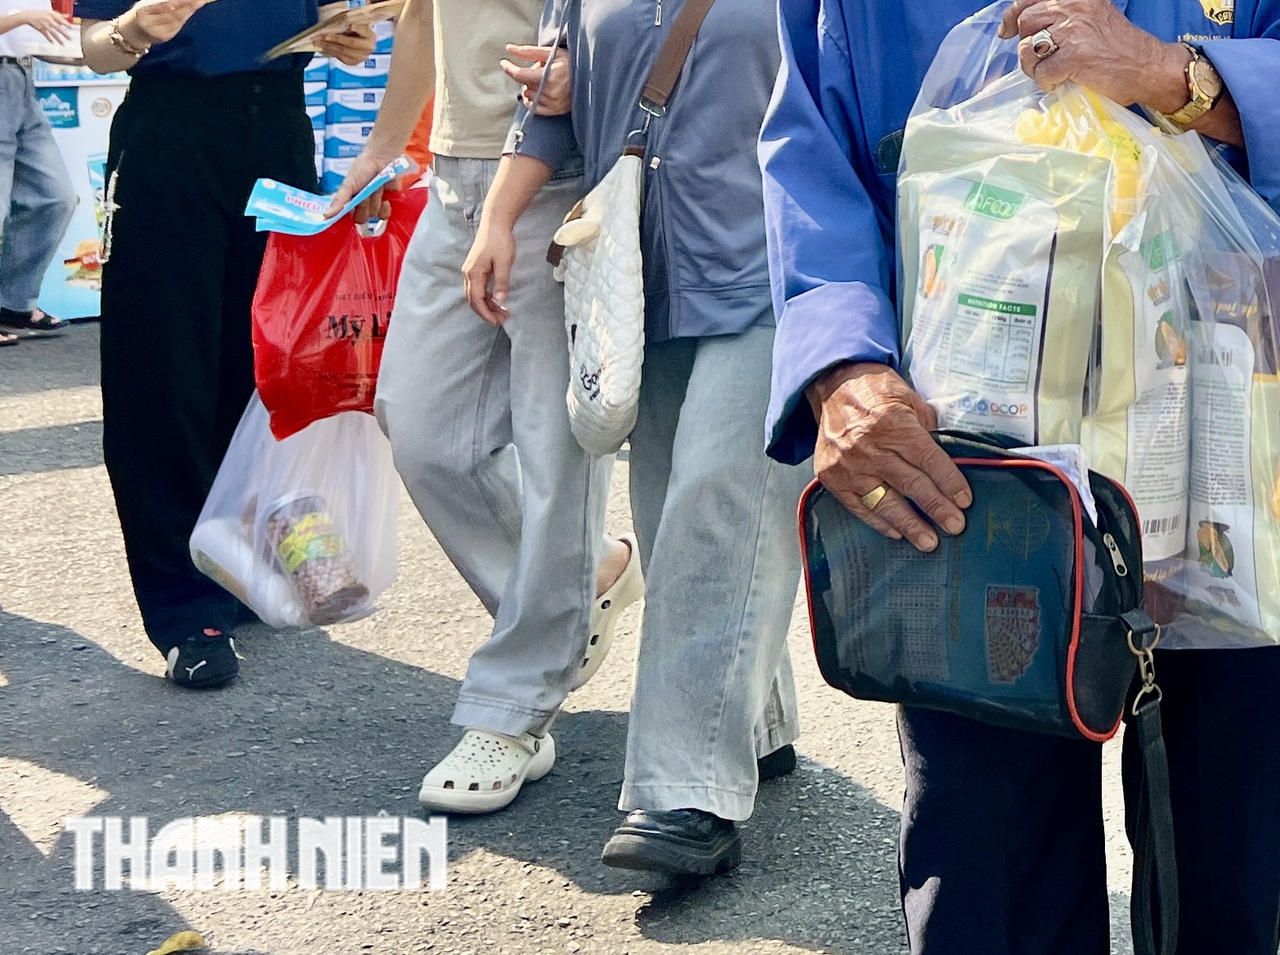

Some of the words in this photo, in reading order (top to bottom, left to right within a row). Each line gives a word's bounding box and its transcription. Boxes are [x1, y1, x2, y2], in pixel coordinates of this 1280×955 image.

[967, 298, 998, 310] NUTRITION
[998, 302, 1021, 313] FACTS
[989, 402, 1028, 415] OCOP
